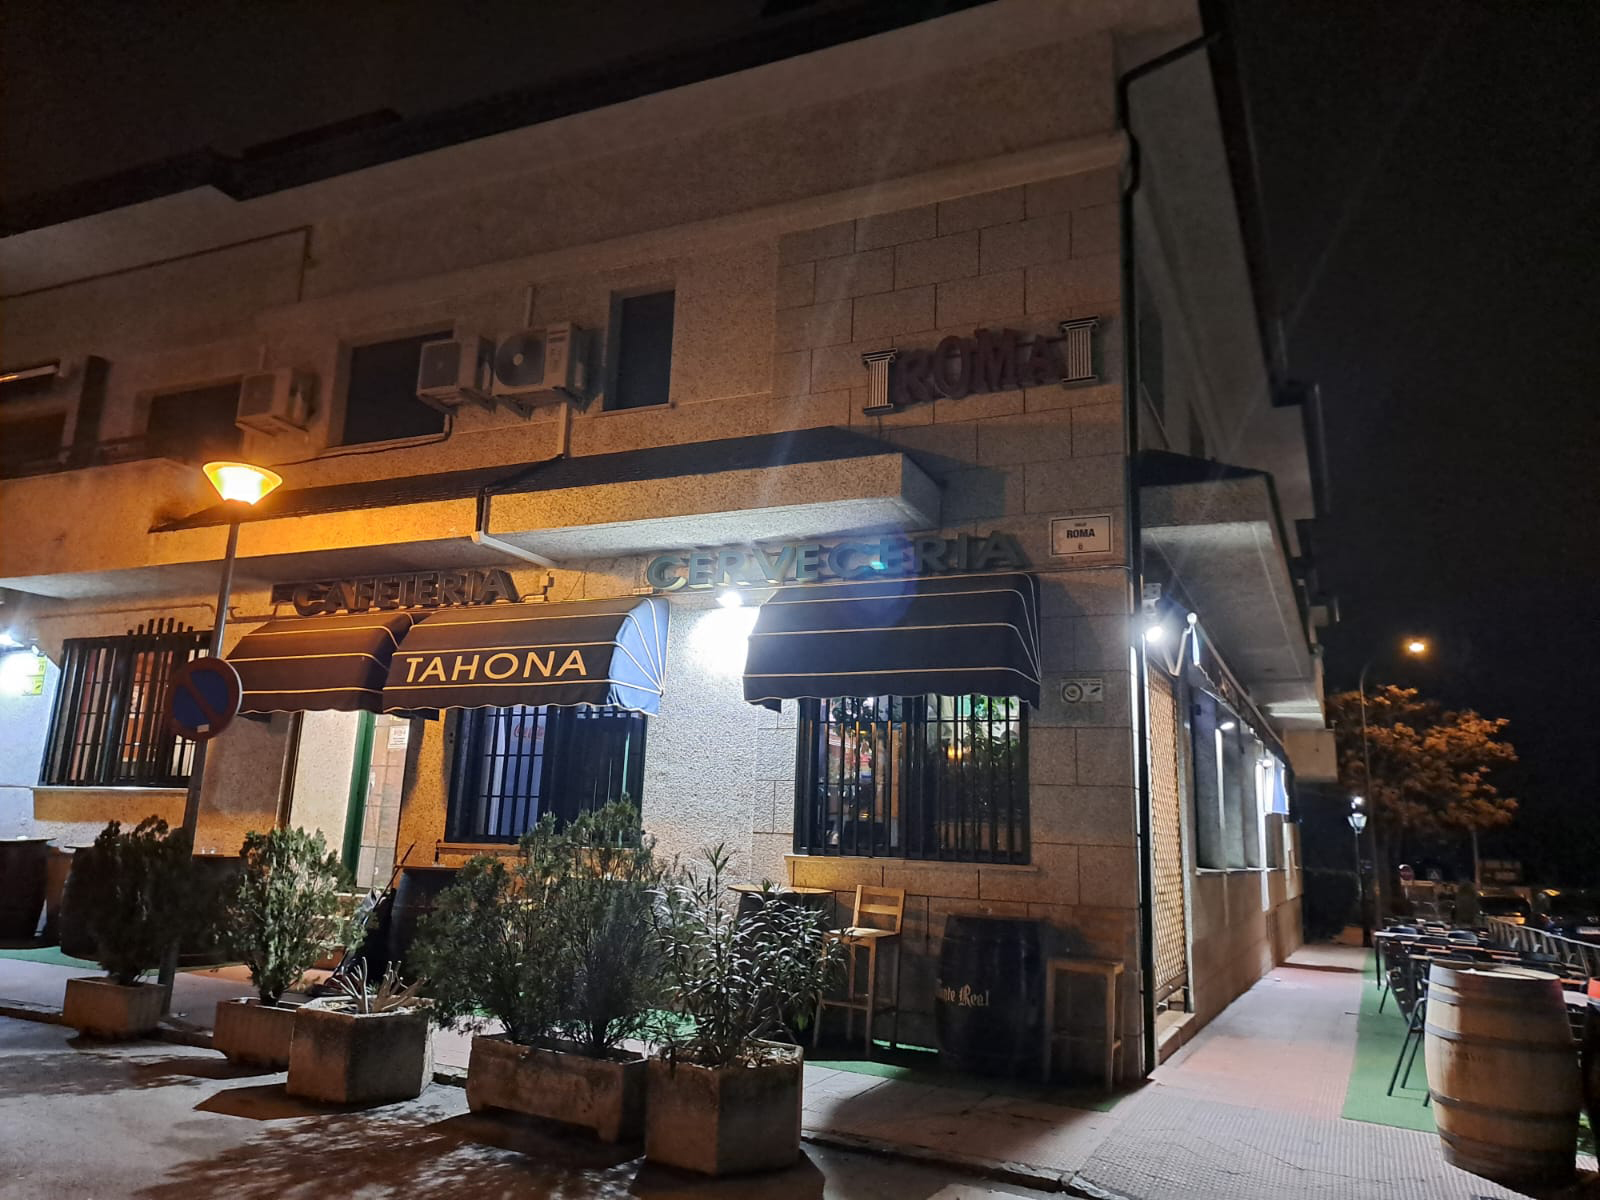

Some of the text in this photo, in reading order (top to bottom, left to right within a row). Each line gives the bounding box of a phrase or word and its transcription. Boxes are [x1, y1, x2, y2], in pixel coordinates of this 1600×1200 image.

[895, 328, 1060, 404] ROMA
[1066, 528, 1096, 539] ROMA
[647, 531, 1024, 591] CERVECERIA
[293, 568, 518, 616] CAFETERIA
[406, 650, 587, 683] TAHONA
[958, 985, 990, 1007] Real
